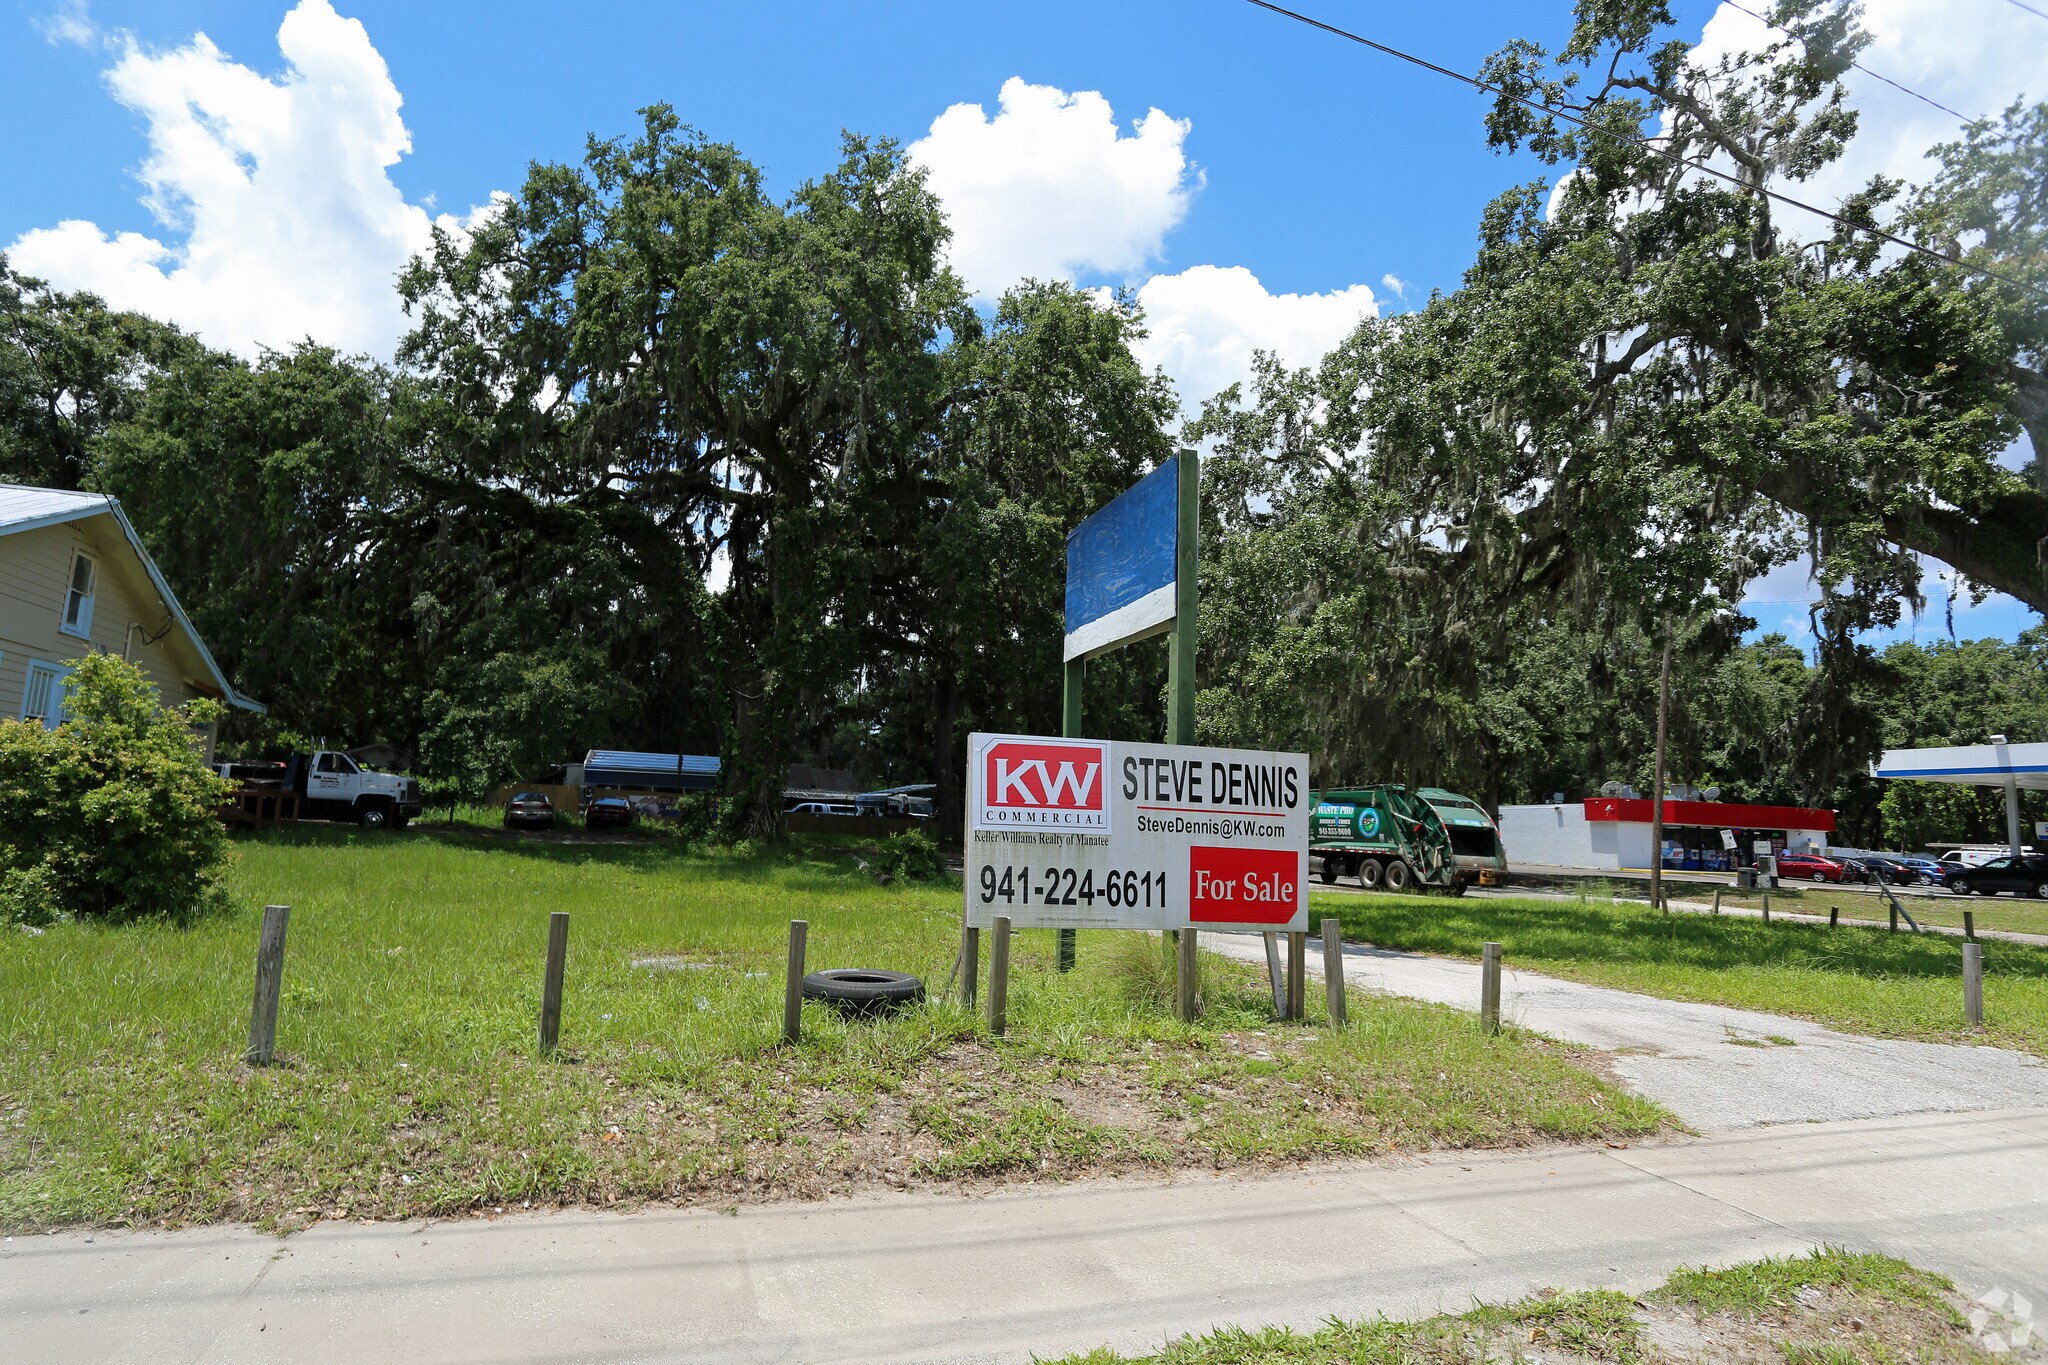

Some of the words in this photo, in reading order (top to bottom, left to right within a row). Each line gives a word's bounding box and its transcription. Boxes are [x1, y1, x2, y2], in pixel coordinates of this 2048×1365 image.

[995, 758, 1100, 807] KW
[1122, 756, 1203, 803] STEVE
[1211, 762, 1298, 809] DENNIS
[986, 810, 1103, 824] COMMERCIAL
[1318, 805, 1339, 815] WASTE
[1339, 805, 1354, 815] PRO
[974, 830, 999, 843] Keller
[1001, 830, 1037, 844] Williams
[1039, 832, 1063, 848] Realty
[1066, 833, 1075, 845] of
[1076, 833, 1109, 846] Manatee
[1137, 815, 1285, 839] SteveDennis@KW.com
[980, 864, 1167, 908] 941-224-6611
[1195, 869, 1236, 900] For
[1243, 872, 1294, 902] Sale
